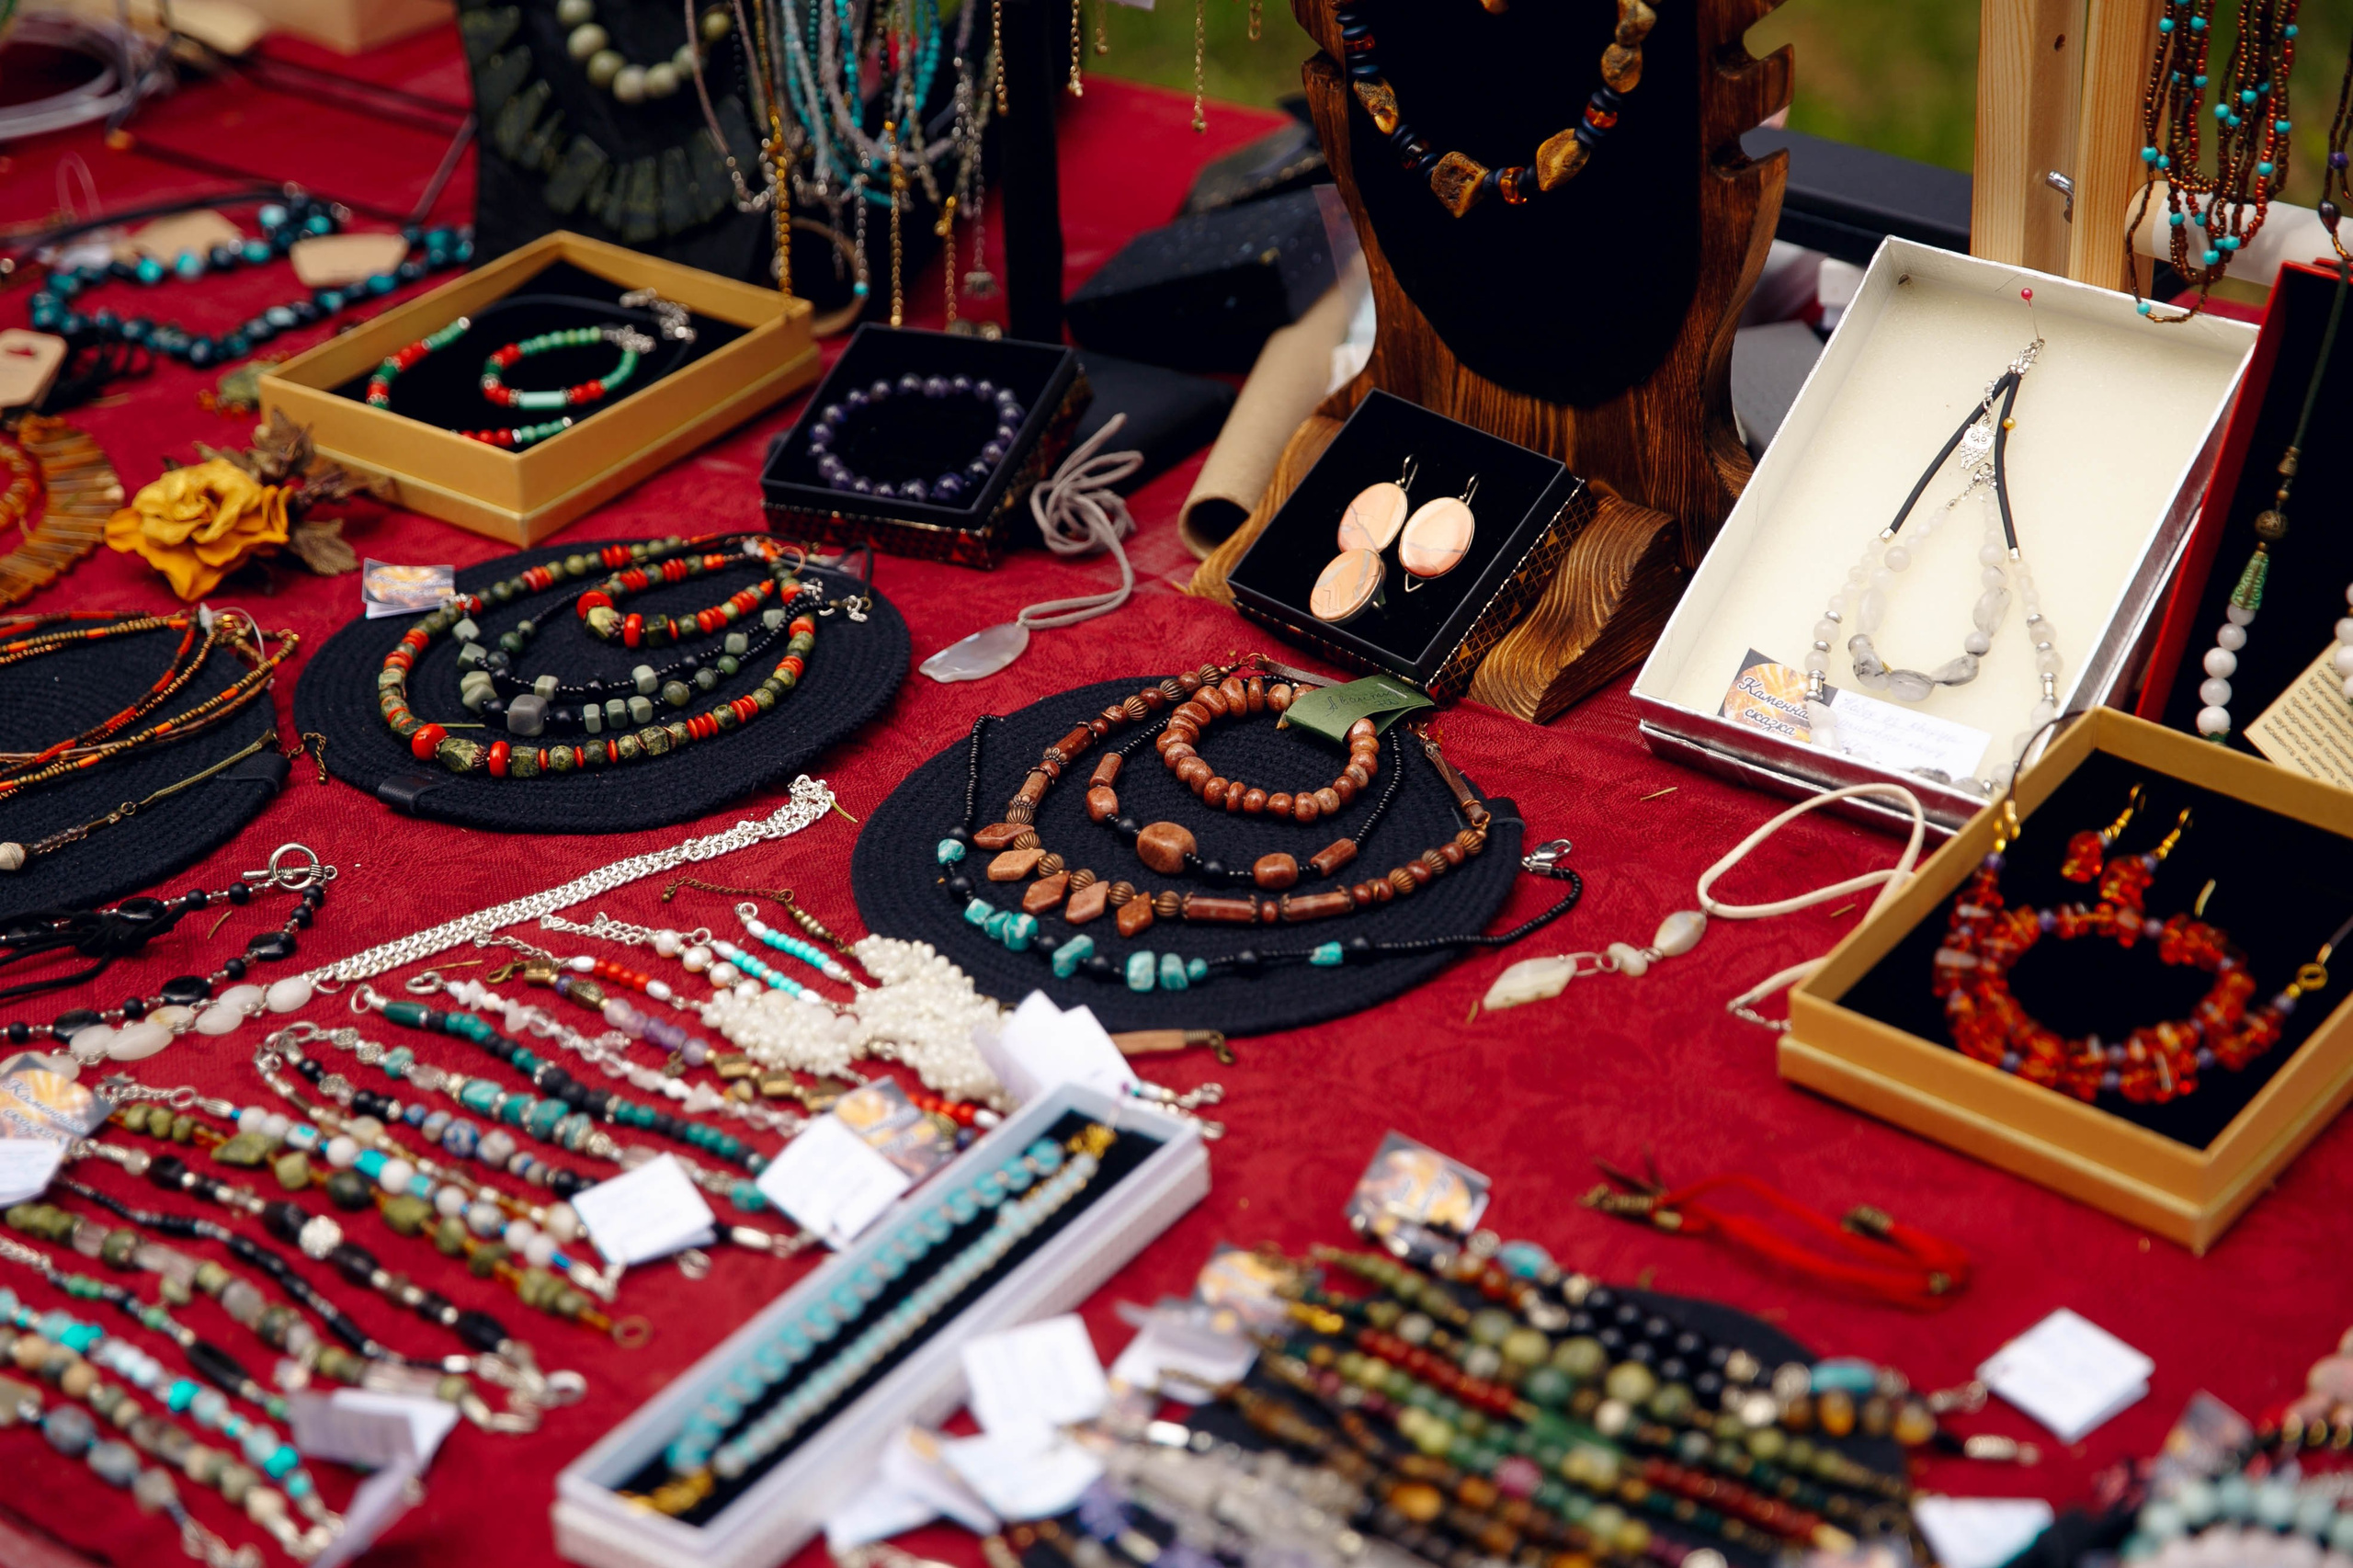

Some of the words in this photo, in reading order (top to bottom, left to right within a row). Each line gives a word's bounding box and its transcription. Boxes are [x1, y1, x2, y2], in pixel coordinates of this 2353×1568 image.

[2325, 661, 2345, 682] жизн
[1737, 676, 1807, 719] Каменна
[1745, 708, 1794, 734] сказка
